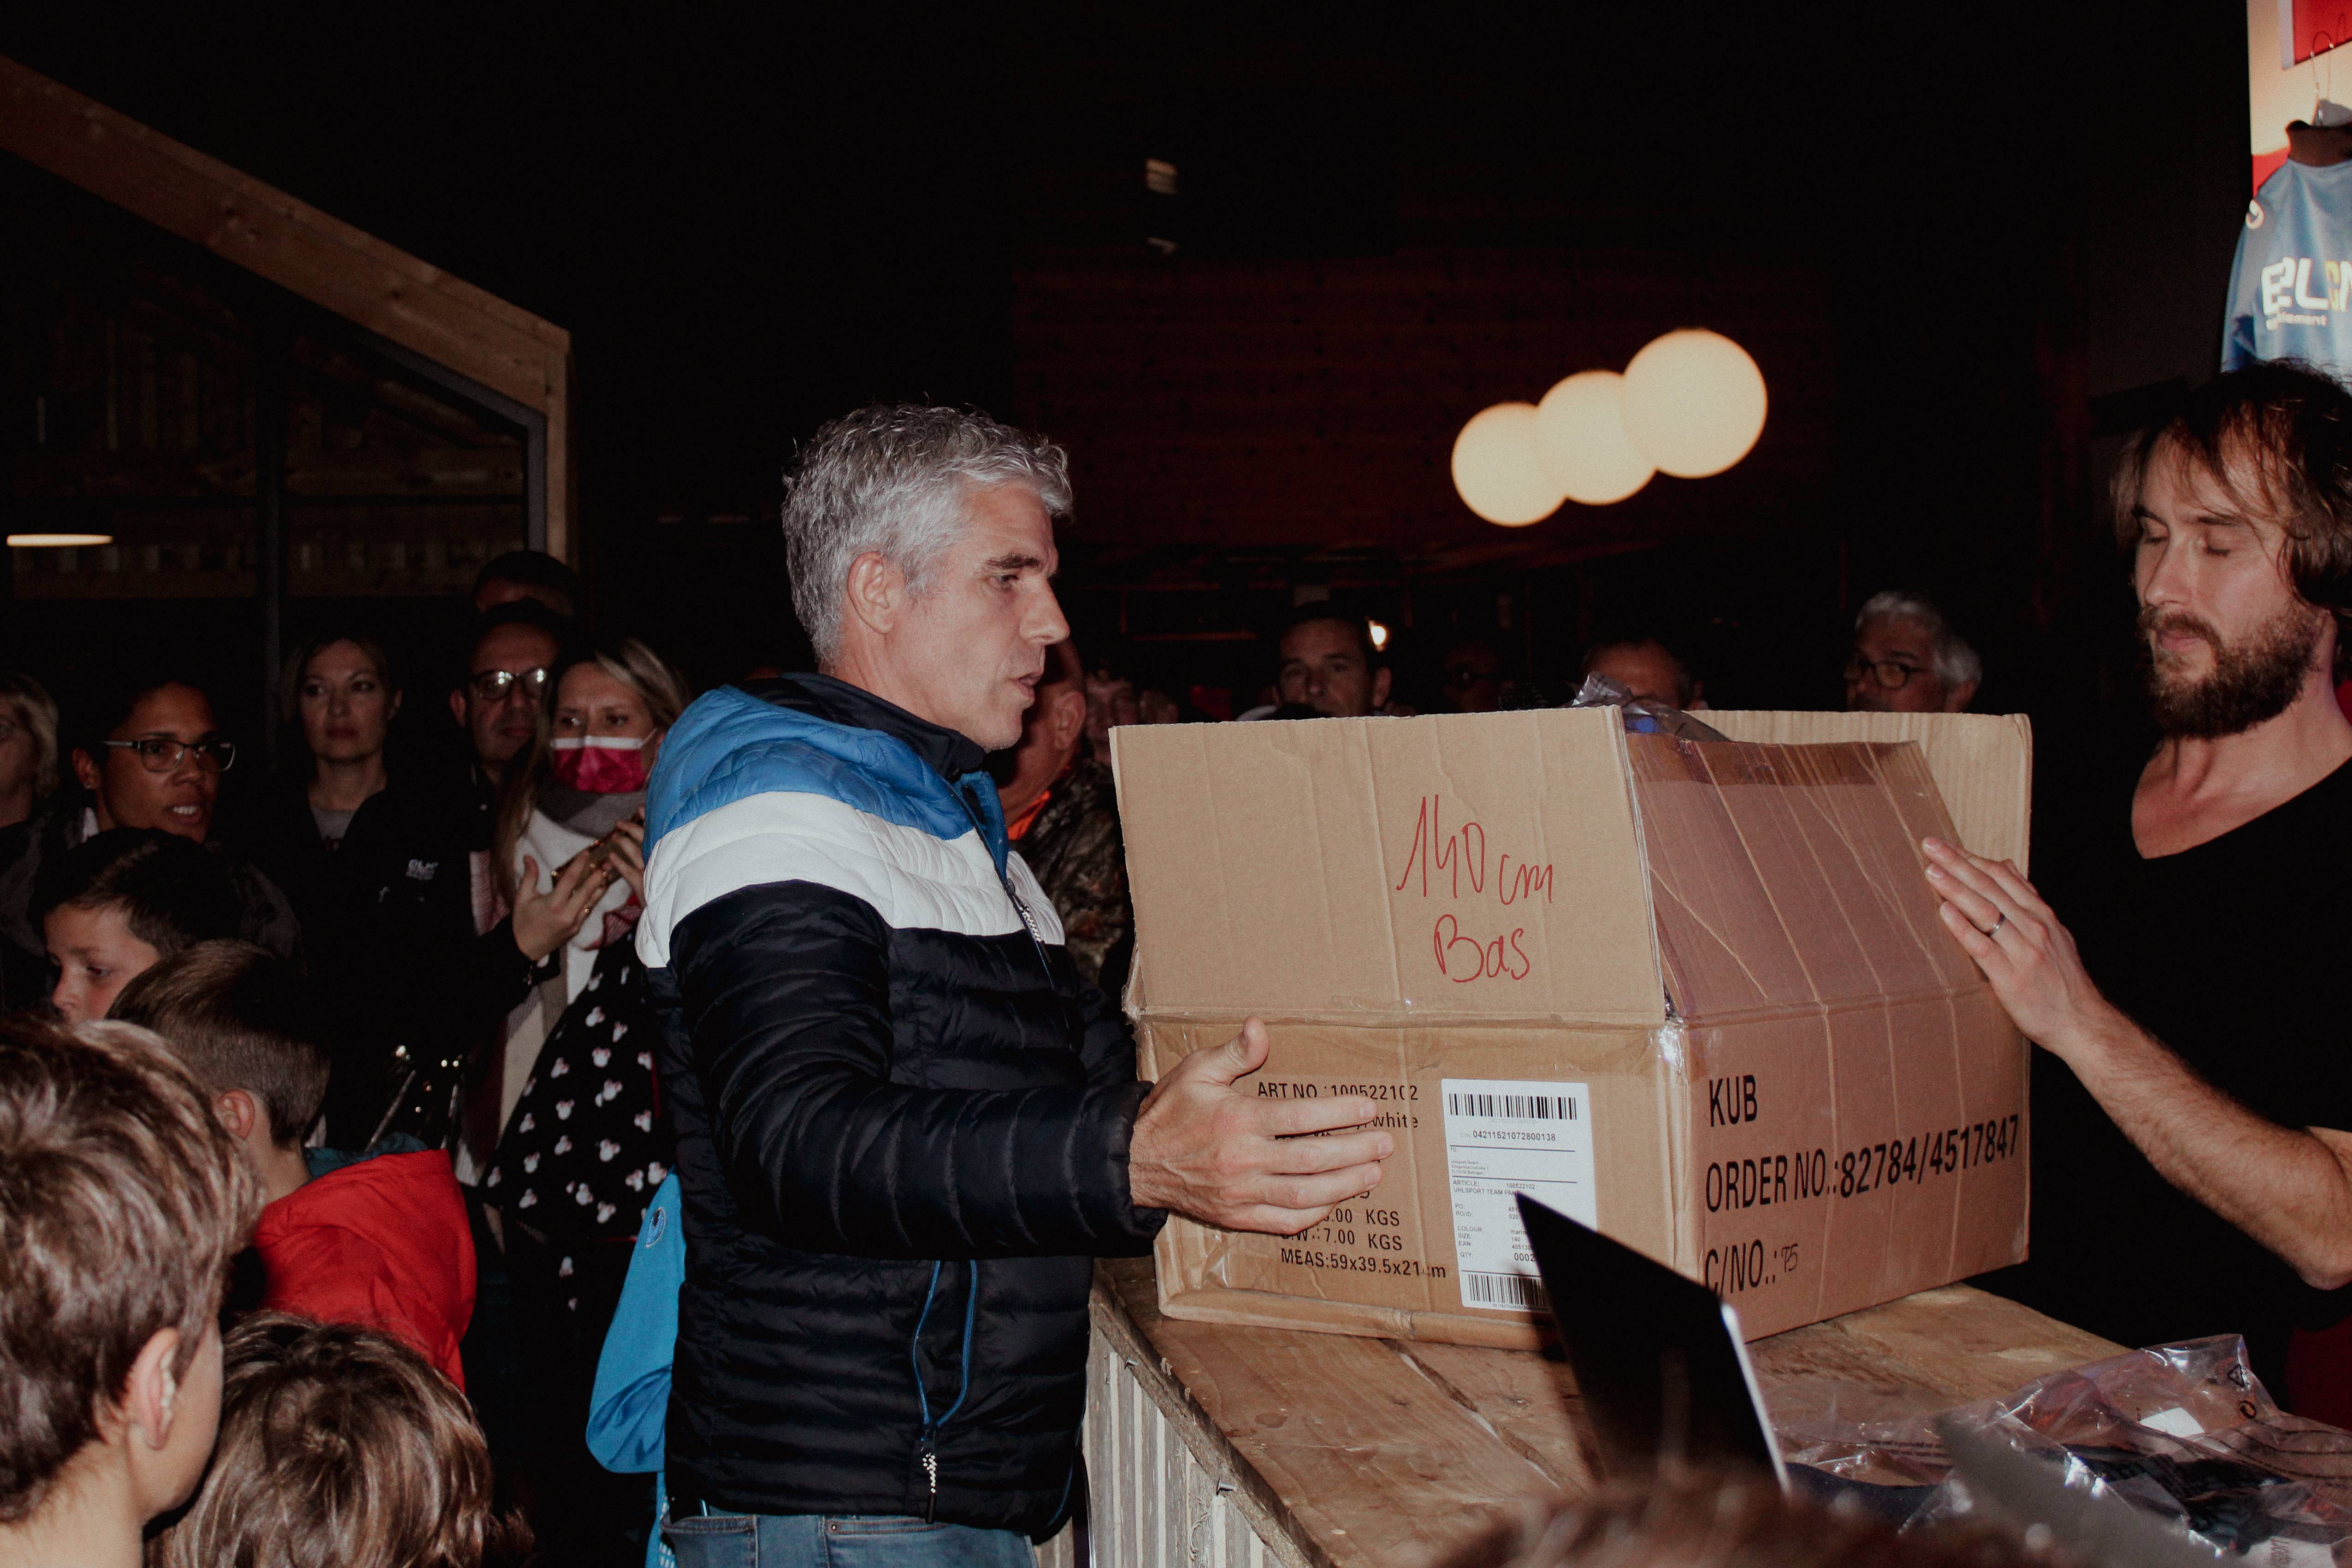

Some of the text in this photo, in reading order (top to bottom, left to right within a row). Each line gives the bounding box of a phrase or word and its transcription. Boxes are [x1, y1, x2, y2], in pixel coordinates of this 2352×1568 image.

[1395, 794, 1553, 905] 140 cm
[1434, 914, 1530, 983] Bas
[1258, 1082, 1288, 1098] ART
[1708, 1074, 1758, 1127] KUB
[1473, 1130, 1556, 1141] 04211521072800138
[1706, 1154, 1788, 1213] ORDER
[1366, 1209, 1400, 1226] KGS
[1368, 1232, 1402, 1250] KGS
[1514, 1252, 1535, 1262] 0002
